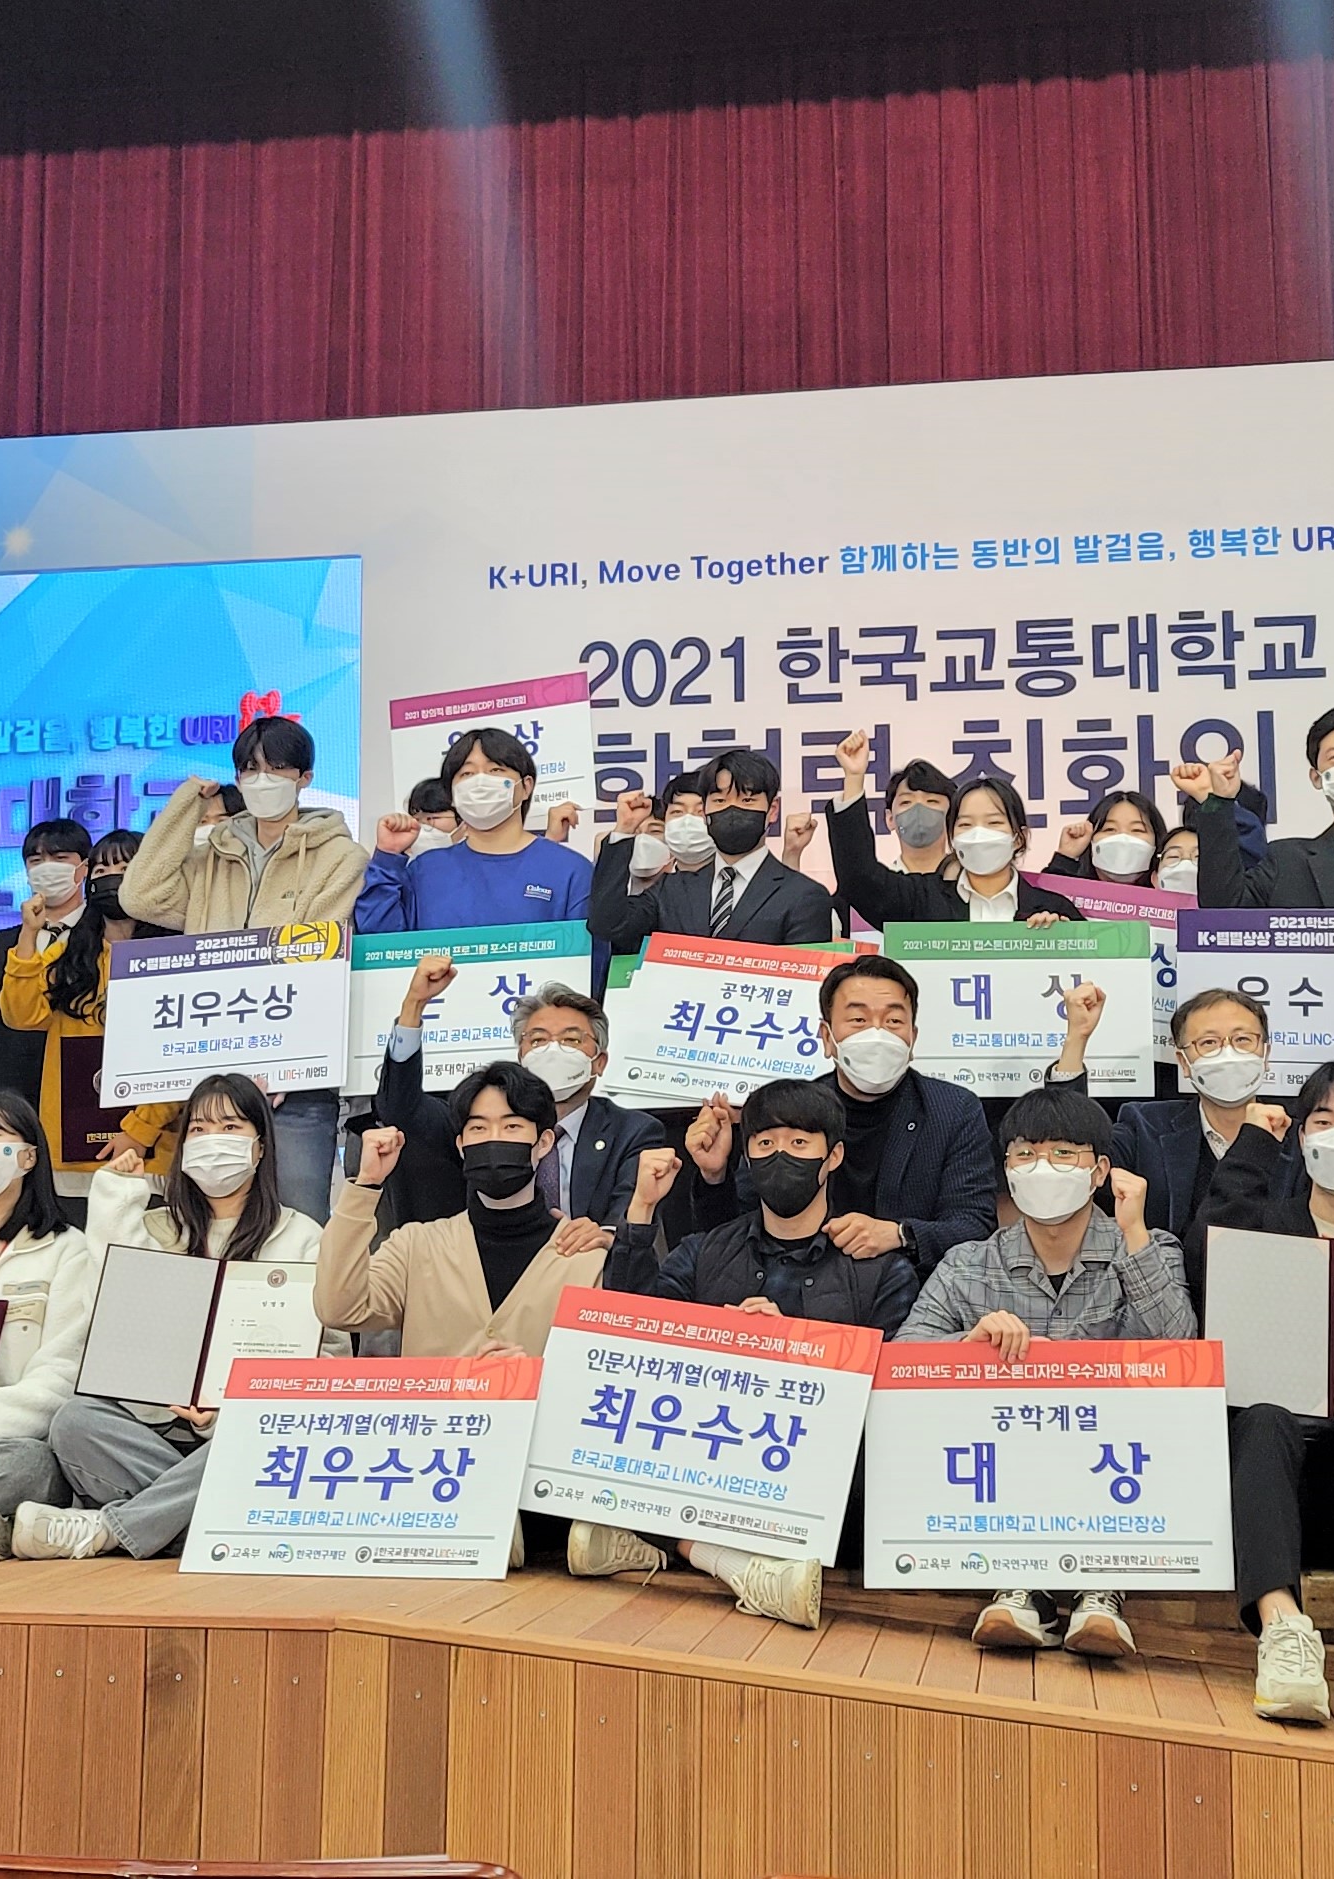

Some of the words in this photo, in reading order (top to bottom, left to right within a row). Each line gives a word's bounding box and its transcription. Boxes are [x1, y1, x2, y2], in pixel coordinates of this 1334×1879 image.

[488, 563, 588, 590] K+URI,
[598, 559, 680, 585] Move
[691, 553, 829, 585] Together
[839, 541, 960, 575] 함께하는
[971, 537, 1060, 570] 동반의
[1074, 531, 1176, 565] 발걸음,
[1188, 527, 1282, 559] 행복한
[579, 635, 746, 708] 2021
[775, 609, 1328, 705] 한국교통대학교
[180, 714, 238, 747] URI
[195, 934, 258, 951] 2021학년도
[365, 952, 383, 961] 2021
[452, 945, 488, 957] 프로그램
[490, 943, 517, 954] 포스터
[519, 940, 555, 952] 경진대회
[951, 940, 970, 951] 교과
[971, 939, 1033, 951] 캡스톤디자인
[1035, 939, 1055, 951] 교내
[1057, 939, 1098, 951] 경진대회
[1197, 931, 1271, 946] K+별별상상
[129, 953, 196, 973] K+별별상상
[199, 946, 272, 966] 창업아이디어
[275, 942, 324, 957] 경진대회
[663, 948, 704, 961] 2021학년도
[705, 952, 724, 964] 교과
[725, 955, 779, 972] 캡스톤디자인
[780, 961, 818, 976] 우수과제
[721, 982, 793, 1006] 공학계열
[153, 983, 297, 1030] 최우수상
[664, 1000, 821, 1057] 최우수상
[952, 1032, 1043, 1048] 한국교통대학교
[162, 1037, 244, 1056] 한국교통대학교
[247, 1033, 283, 1049] 총장상
[656, 1045, 729, 1065] 한국교통대학교
[730, 1055, 815, 1076] LINC+사업단장상
[643, 1071, 665, 1081] 교육부
[692, 1078, 729, 1090] 한국연구재단
[978, 1073, 1021, 1081] 한국연구재단
[578, 1308, 633, 1330] 2021학년도
[634, 1317, 660, 1333] 교과
[662, 1321, 734, 1346] 캡스톤디자인
[736, 1332, 785, 1354] 우수과제
[788, 1341, 825, 1358] 계획서
[586, 1348, 770, 1399] 인문사회계열(예체능
[775, 1378, 826, 1406] 포함)
[891, 1364, 951, 1379] 2021학년도
[954, 1364, 981, 1379] 교과
[985, 1364, 1064, 1380] 캡스톤디자인
[1067, 1363, 1121, 1379] 우수과제
[1125, 1362, 1166, 1379] 계획서
[249, 1378, 303, 1390] 2021학년도
[304, 1379, 329, 1391] 교과
[331, 1379, 401, 1392] 캡스톤디자인
[403, 1379, 451, 1392] 우수과제
[453, 1379, 490, 1392] 계획서
[258, 1413, 438, 1436] 인문사회계열(예체능
[443, 1414, 491, 1436] 포함)
[581, 1384, 807, 1472] 최우수상
[991, 1404, 1098, 1432] 공학계열
[255, 1445, 476, 1503] 최우수상
[571, 1449, 670, 1481] 한국교통대학교
[672, 1466, 788, 1501] LINC+사업단장상
[554, 1485, 584, 1501] 교육부
[592, 1494, 614, 1507] NRF
[620, 1499, 671, 1517] 한국연구재단
[247, 1509, 343, 1527] 한국교통대학교
[346, 1510, 459, 1529] LINC+사업단장상
[926, 1515, 1037, 1533] 한국교통대학교
[1040, 1514, 1166, 1533] LINC+사업단장상
[231, 1547, 261, 1559] 교육부
[269, 1549, 290, 1560] NRF
[296, 1549, 346, 1560] 한국연구재단
[919, 1558, 951, 1570] 교육부
[961, 1559, 985, 1571] NRF
[992, 1558, 1048, 1570] 한국연구재단
